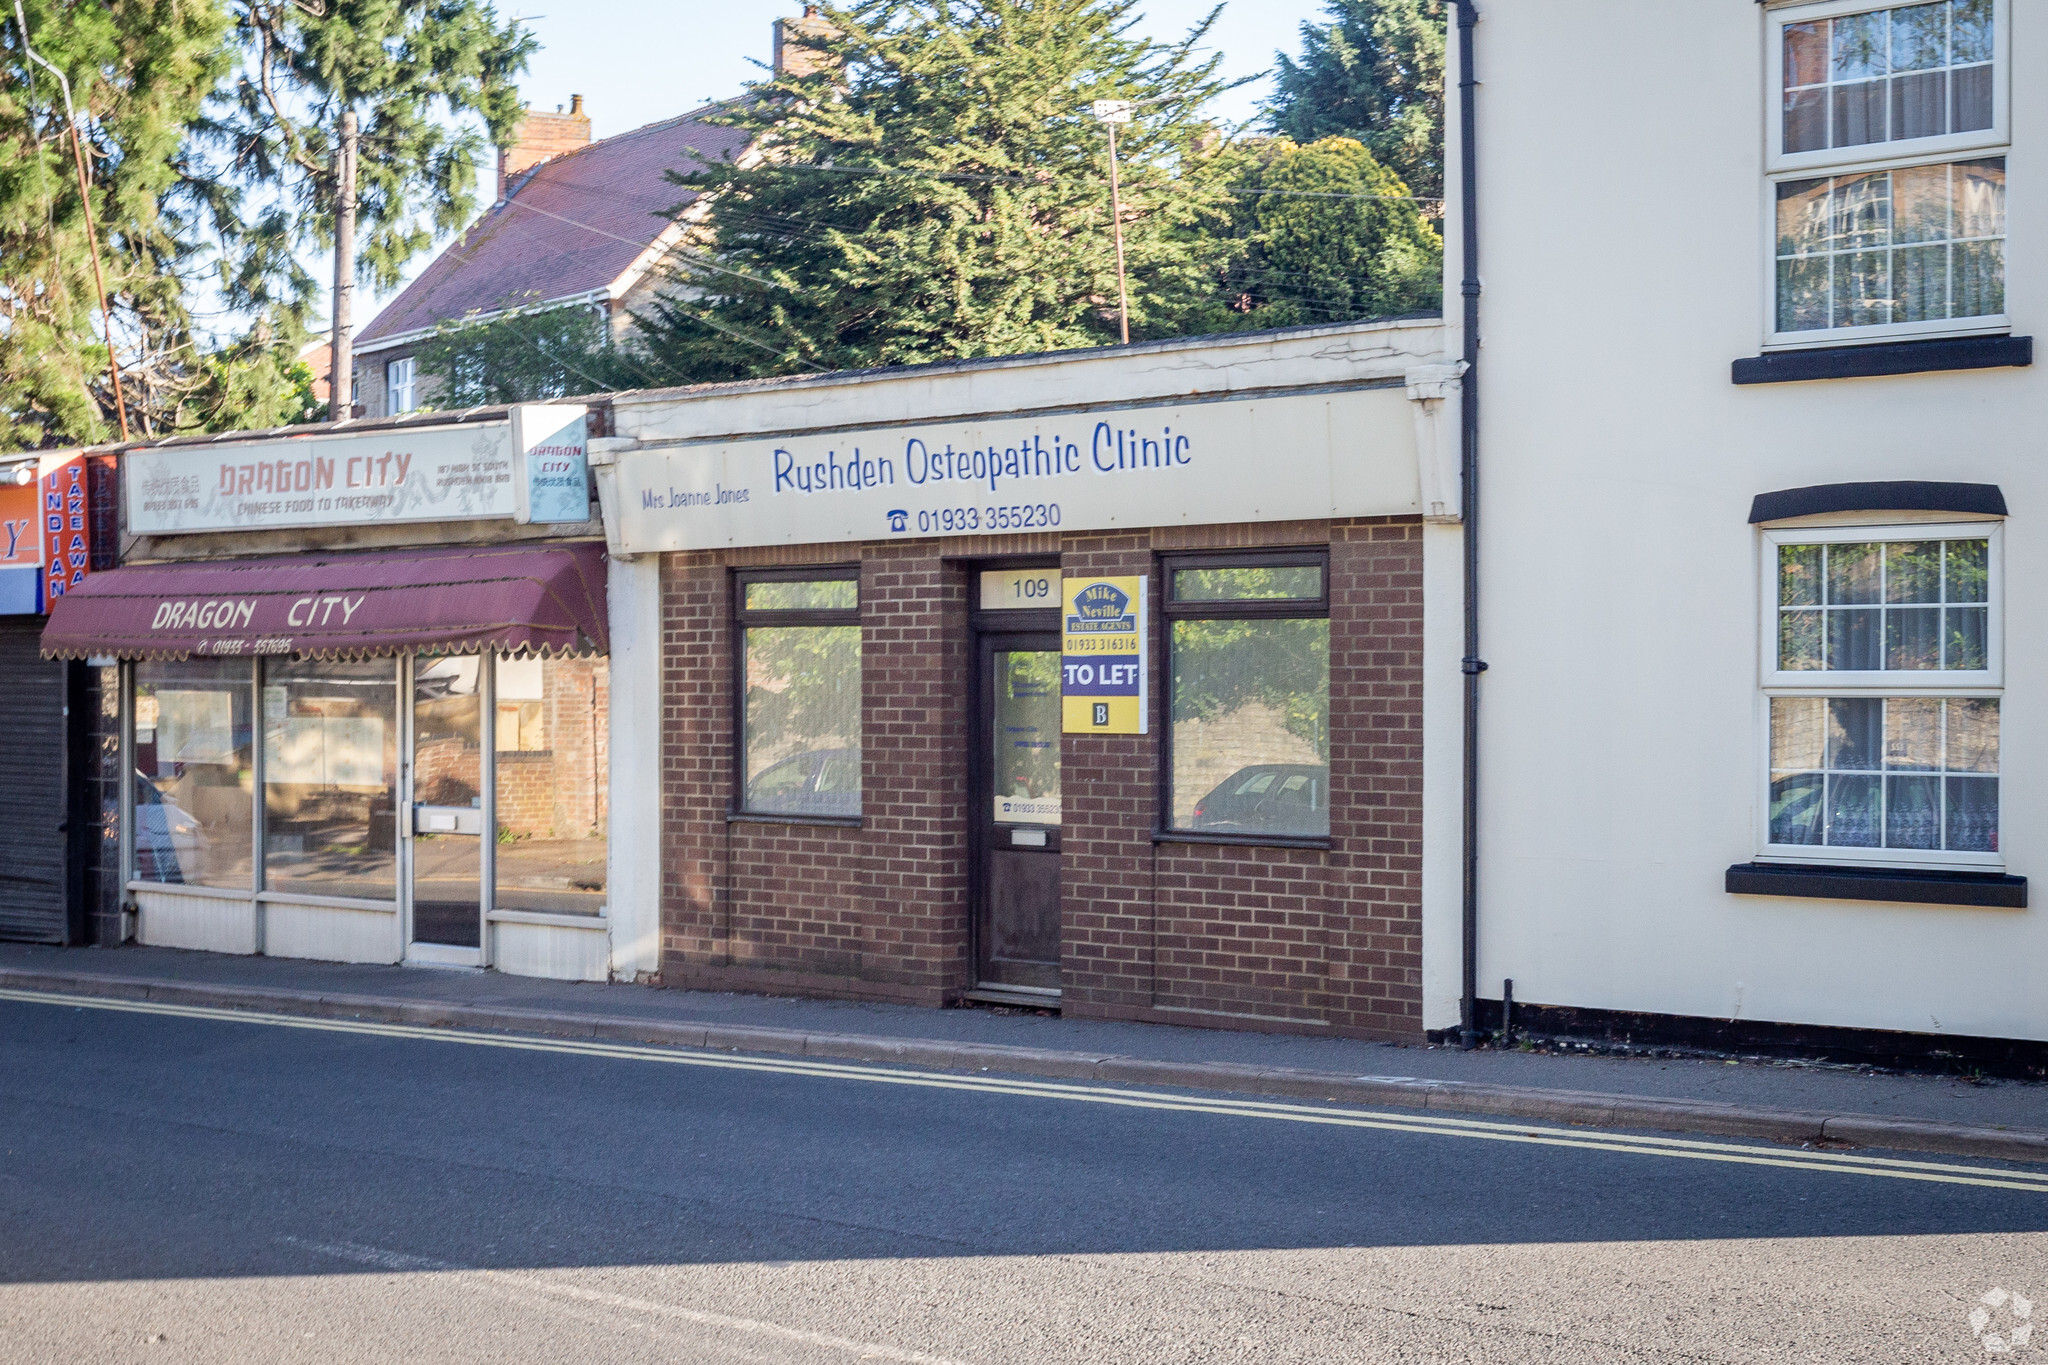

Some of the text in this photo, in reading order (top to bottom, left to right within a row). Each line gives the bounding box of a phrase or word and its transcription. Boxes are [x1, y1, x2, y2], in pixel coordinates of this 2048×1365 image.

[529, 446, 582, 456] DRAGON
[774, 421, 1192, 494] Rushden Osteopathic Clinic
[219, 456, 335, 496] DRAGON
[346, 451, 412, 488] CITY
[542, 462, 571, 472] CITY
[237, 495, 394, 516] CHINESE FOOD TO TAKEAWAY
[642, 482, 750, 510] Mrs Joanne Jones
[67, 465, 88, 586] TAKEAWA
[918, 502, 1061, 532] 01933 355230
[2, 519, 29, 560] Y
[47, 470, 66, 599] INDIAN
[1013, 578, 1049, 598] 109
[1086, 585, 1118, 602] Mike
[151, 595, 365, 630] DRAGON CITY
[1082, 604, 1121, 618] Neville
[1071, 621, 1131, 631] ESTATE AGENTS
[253, 638, 293, 653] 357695
[1067, 638, 1136, 650] 01933 316316
[1064, 664, 1138, 685] TO LET
